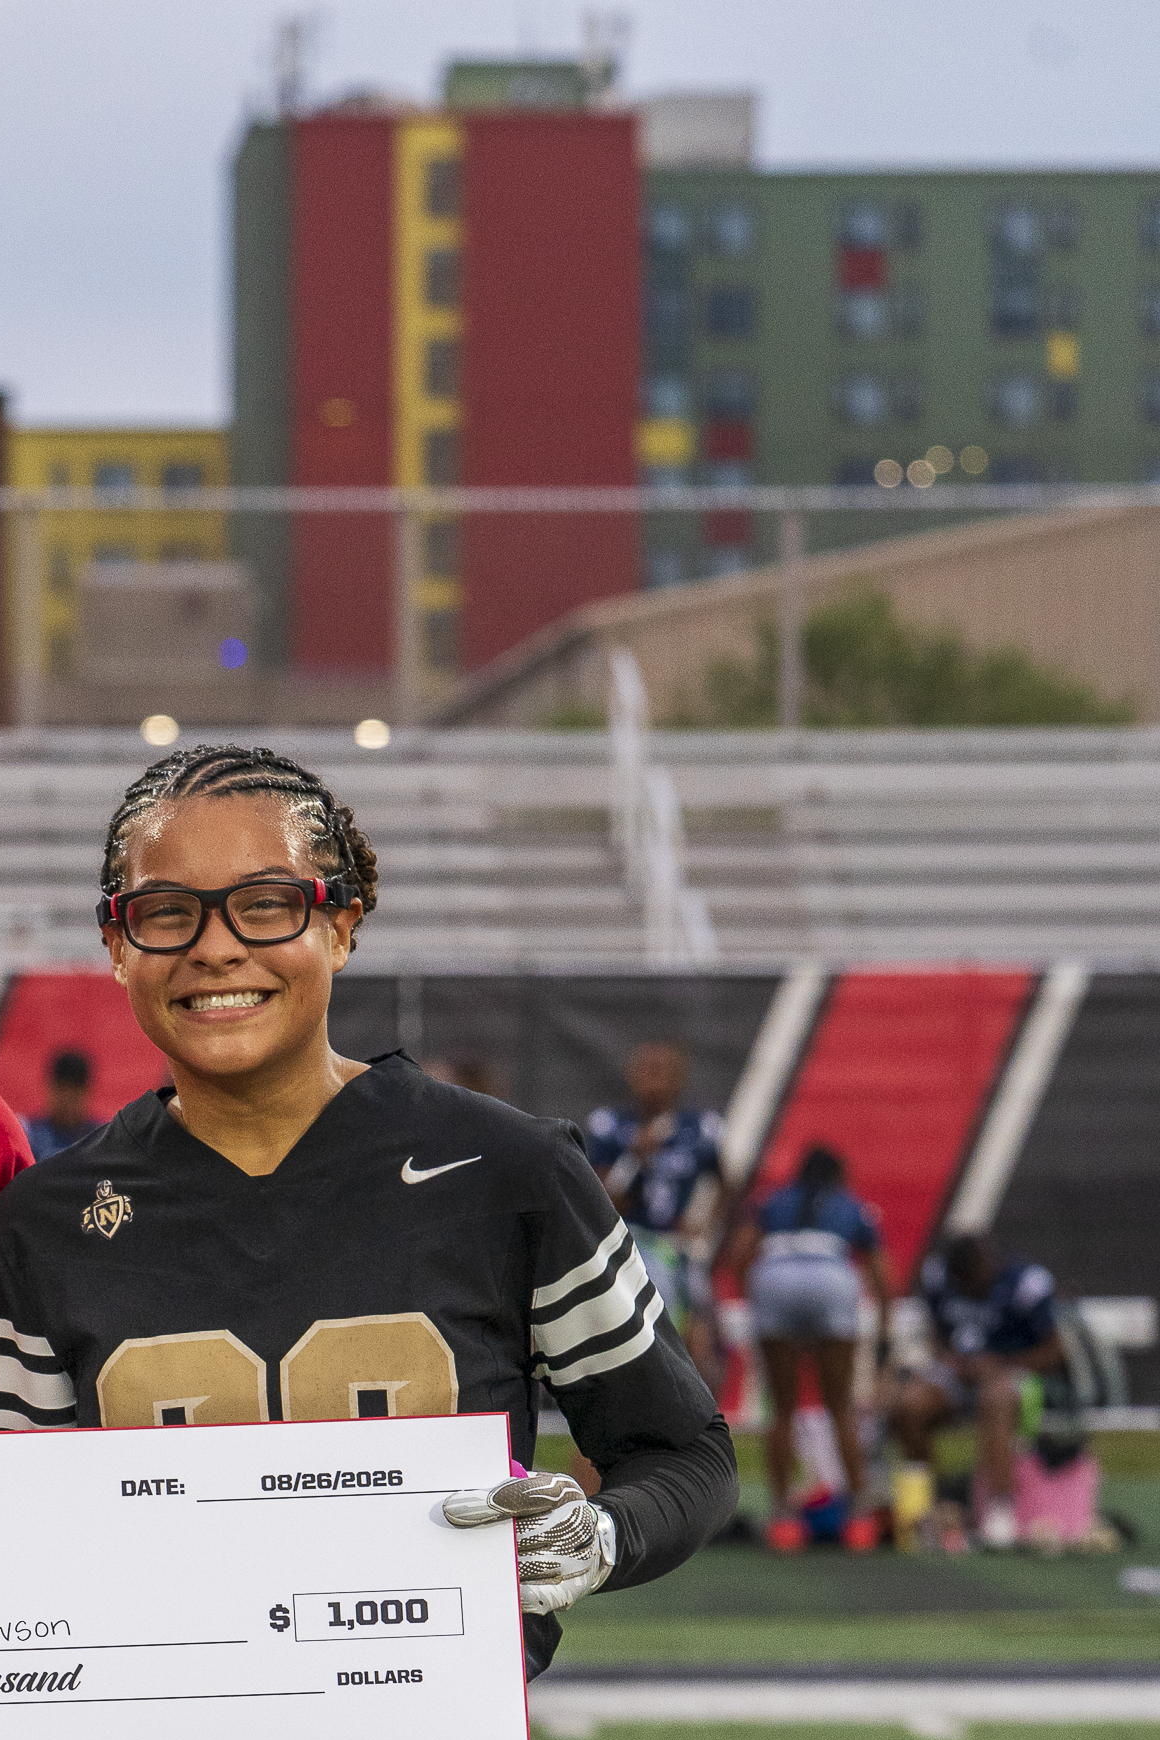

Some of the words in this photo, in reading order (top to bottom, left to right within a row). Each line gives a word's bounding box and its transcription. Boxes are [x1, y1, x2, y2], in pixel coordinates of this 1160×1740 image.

[98, 1203, 119, 1226] N
[120, 1478, 186, 1497] DATE:
[260, 1469, 404, 1492] 08/26/2026
[268, 1603, 291, 1633] $
[327, 1598, 429, 1631] 1,000
[336, 1669, 423, 1686] DOLLARS
